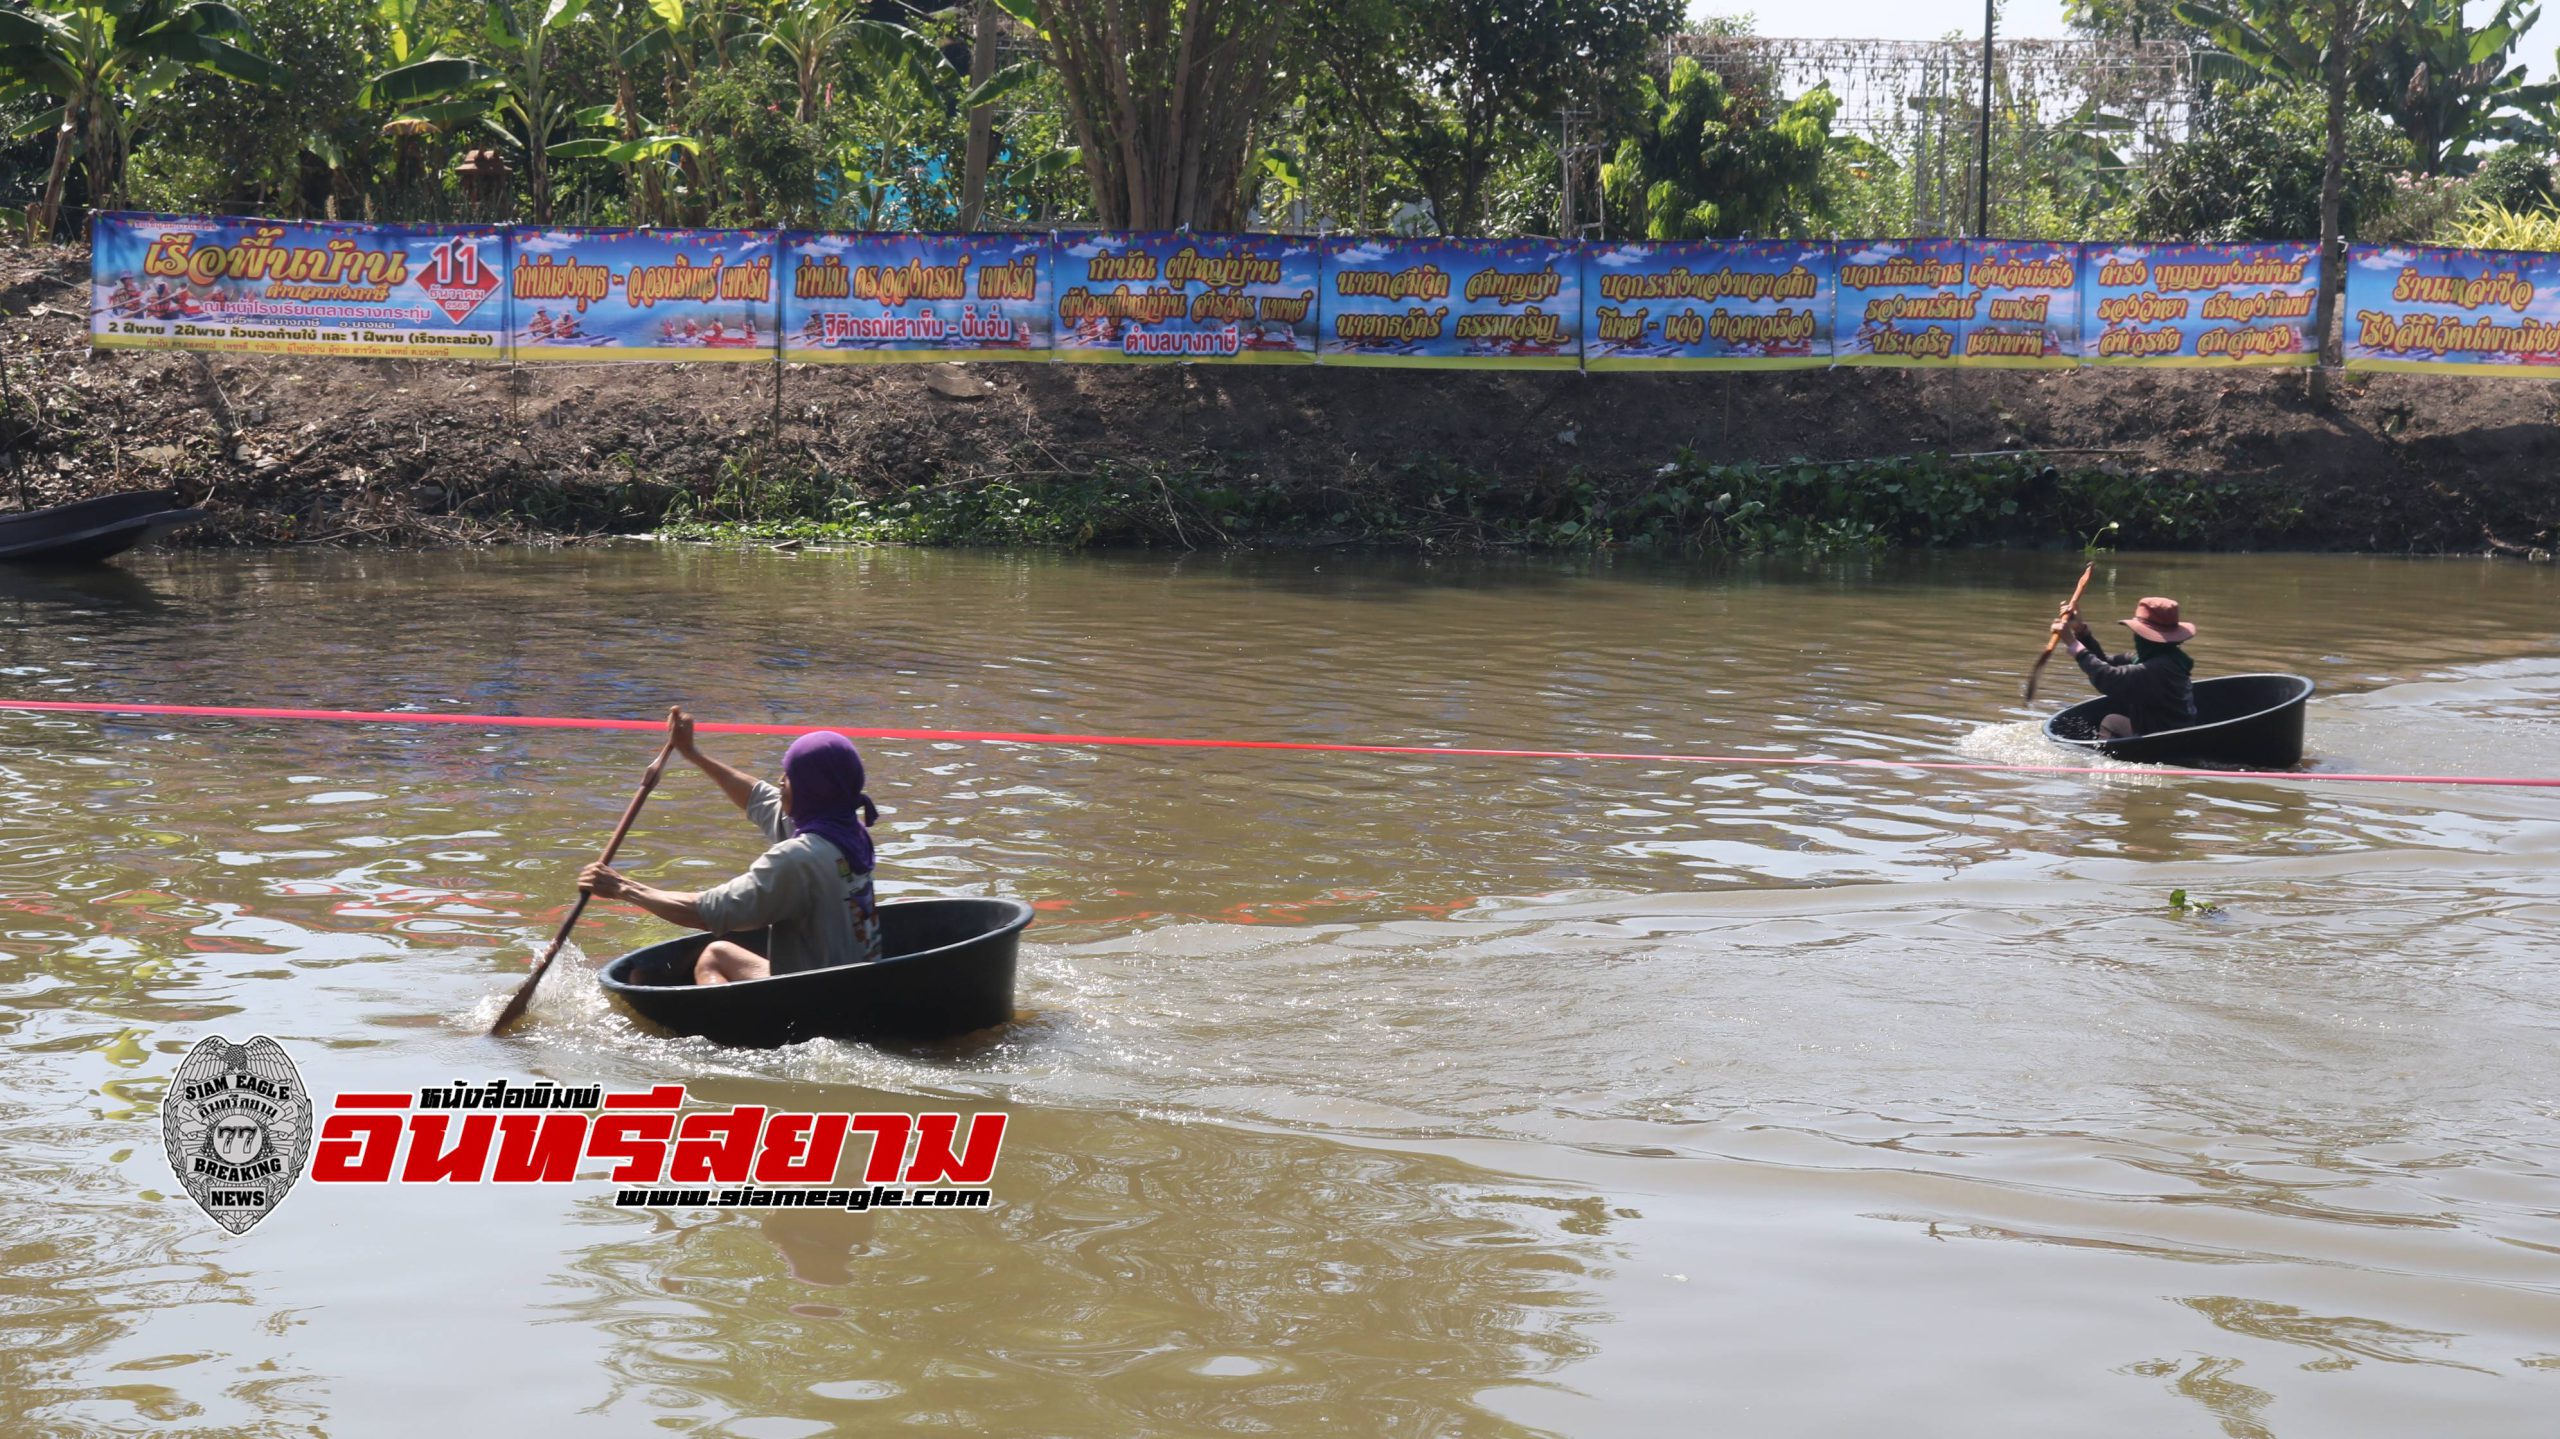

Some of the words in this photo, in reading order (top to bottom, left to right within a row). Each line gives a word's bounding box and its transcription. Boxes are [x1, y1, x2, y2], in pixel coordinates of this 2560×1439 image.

[144, 227, 408, 286] เรือพื้นบ้าน
[431, 243, 477, 285] 11
[1088, 249, 1157, 281] กำนัน
[1165, 248, 1281, 288] ผู้ใหญ่บ้าน
[2098, 258, 2148, 287] ดำรง
[266, 281, 390, 302] ตำบลบางภาษี
[429, 284, 485, 300] ธันวาคม
[721, 255, 772, 303] เพชรดี
[795, 255, 849, 299] กำนัน
[978, 255, 1037, 301] เพชรดี
[203, 301, 220, 314] ณ
[225, 300, 431, 324] หน้าโรงเรียนตลาดรางกระทุ่ม
[445, 301, 470, 311] 2565
[1989, 294, 2050, 324] เพชรดี
[2097, 291, 2188, 324] รองวิทยา
[108, 322, 119, 333] 2
[123, 321, 165, 334] ฝีพาย
[322, 330, 347, 342] และ
[351, 331, 358, 342] 1
[363, 330, 404, 343] ฝีพาย
[408, 331, 494, 346] (เรือกะละมัง)
[824, 310, 944, 344] ฐิติกรณ์เสาเข็ม
[961, 305, 1010, 338] ปั้นจั่น
[1125, 325, 1238, 353] ตำบลบางภาษี
[1456, 306, 1570, 343] ธรรมเจริญ
[1873, 325, 1953, 359] ประเสริฐ
